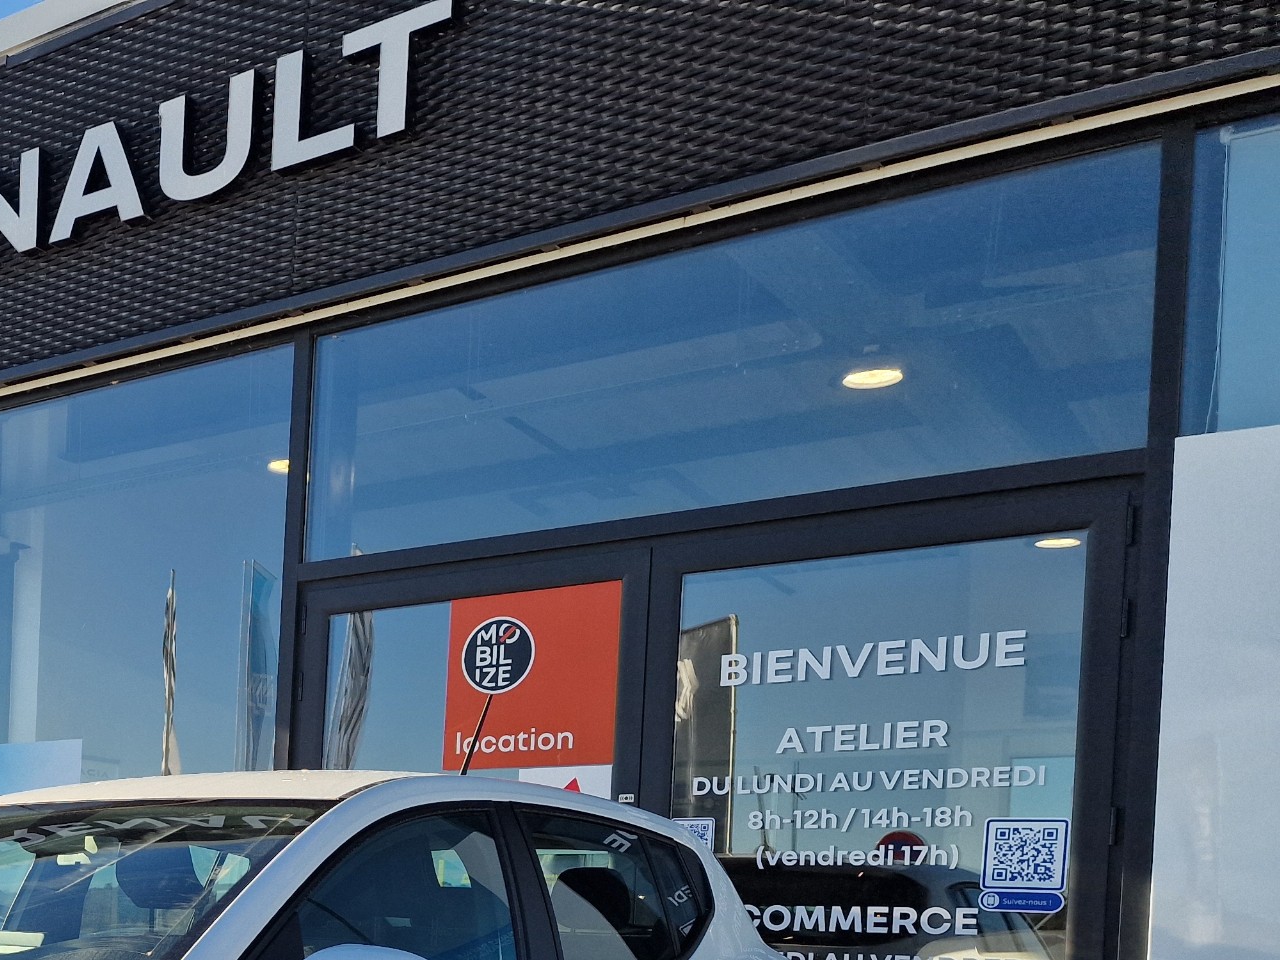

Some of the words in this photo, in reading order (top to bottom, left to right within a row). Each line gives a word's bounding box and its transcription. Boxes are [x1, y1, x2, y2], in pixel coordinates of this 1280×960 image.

[719, 629, 1027, 687] BIENVENUE
[455, 727, 574, 755] location
[775, 719, 949, 754] ATELIER
[692, 775, 731, 797] DU
[736, 773, 823, 795] LUNDI
[829, 770, 873, 793] AU
[879, 765, 1046, 791] VENDREDI
[756, 845, 894, 869] (vendredi
[899, 844, 959, 869] 17h)
[1002, 898, 1047, 906] Suivez-nous
